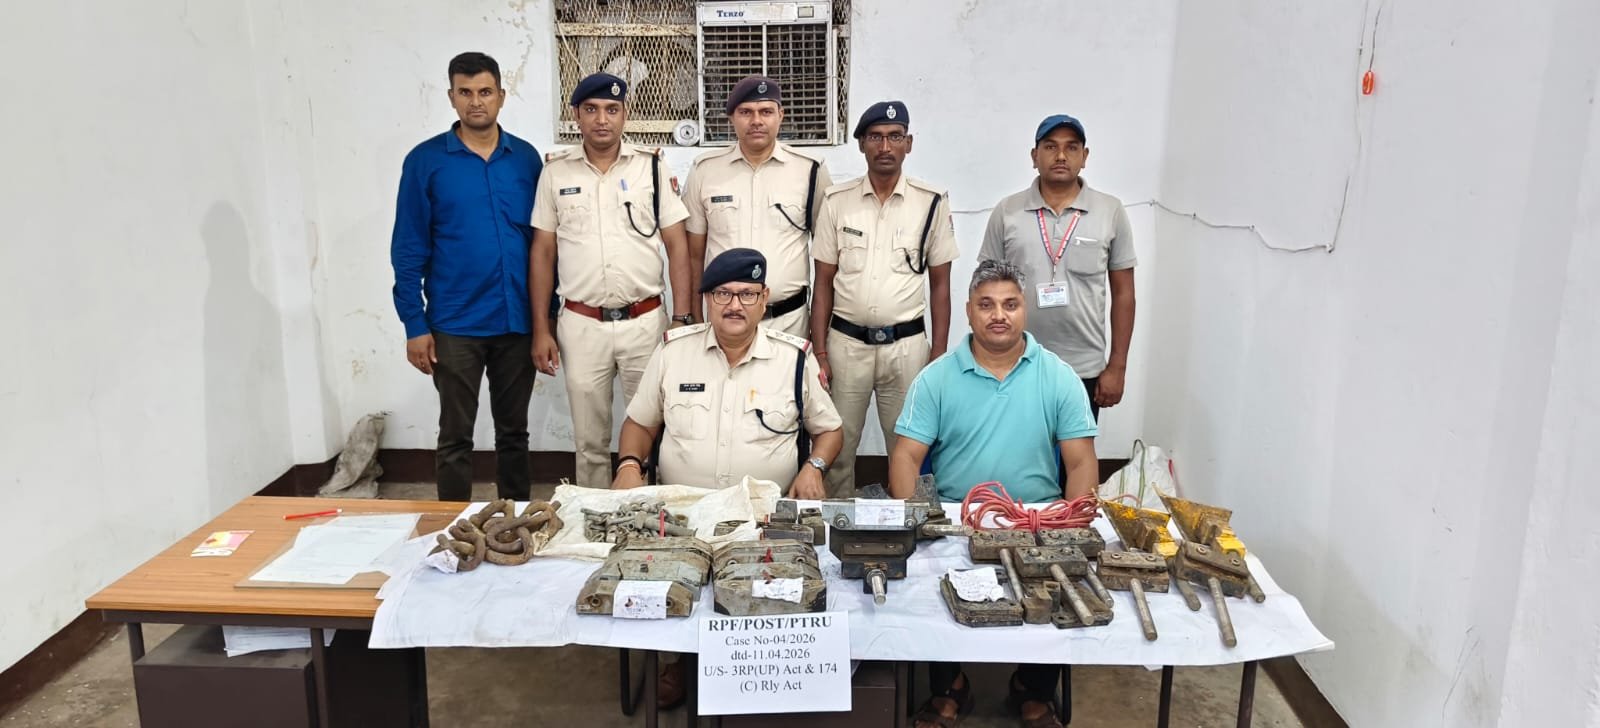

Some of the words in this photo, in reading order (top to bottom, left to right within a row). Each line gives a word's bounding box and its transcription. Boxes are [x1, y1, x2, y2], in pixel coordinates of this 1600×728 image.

[709, 616, 832, 631] RPF/POST/PTRU
[725, 636, 751, 646] Case
[753, 634, 816, 646] No-04/2026
[731, 648, 810, 660] dtd-11.04.2026
[703, 665, 729, 677] U/S-
[731, 665, 780, 677] 3RP(UP)
[783, 664, 801, 675] Act
[804, 664, 815, 674] &
[818, 663, 837, 674] 174
[739, 681, 757, 693] (C)
[761, 681, 780, 693] Rly
[783, 680, 803, 691] Act
